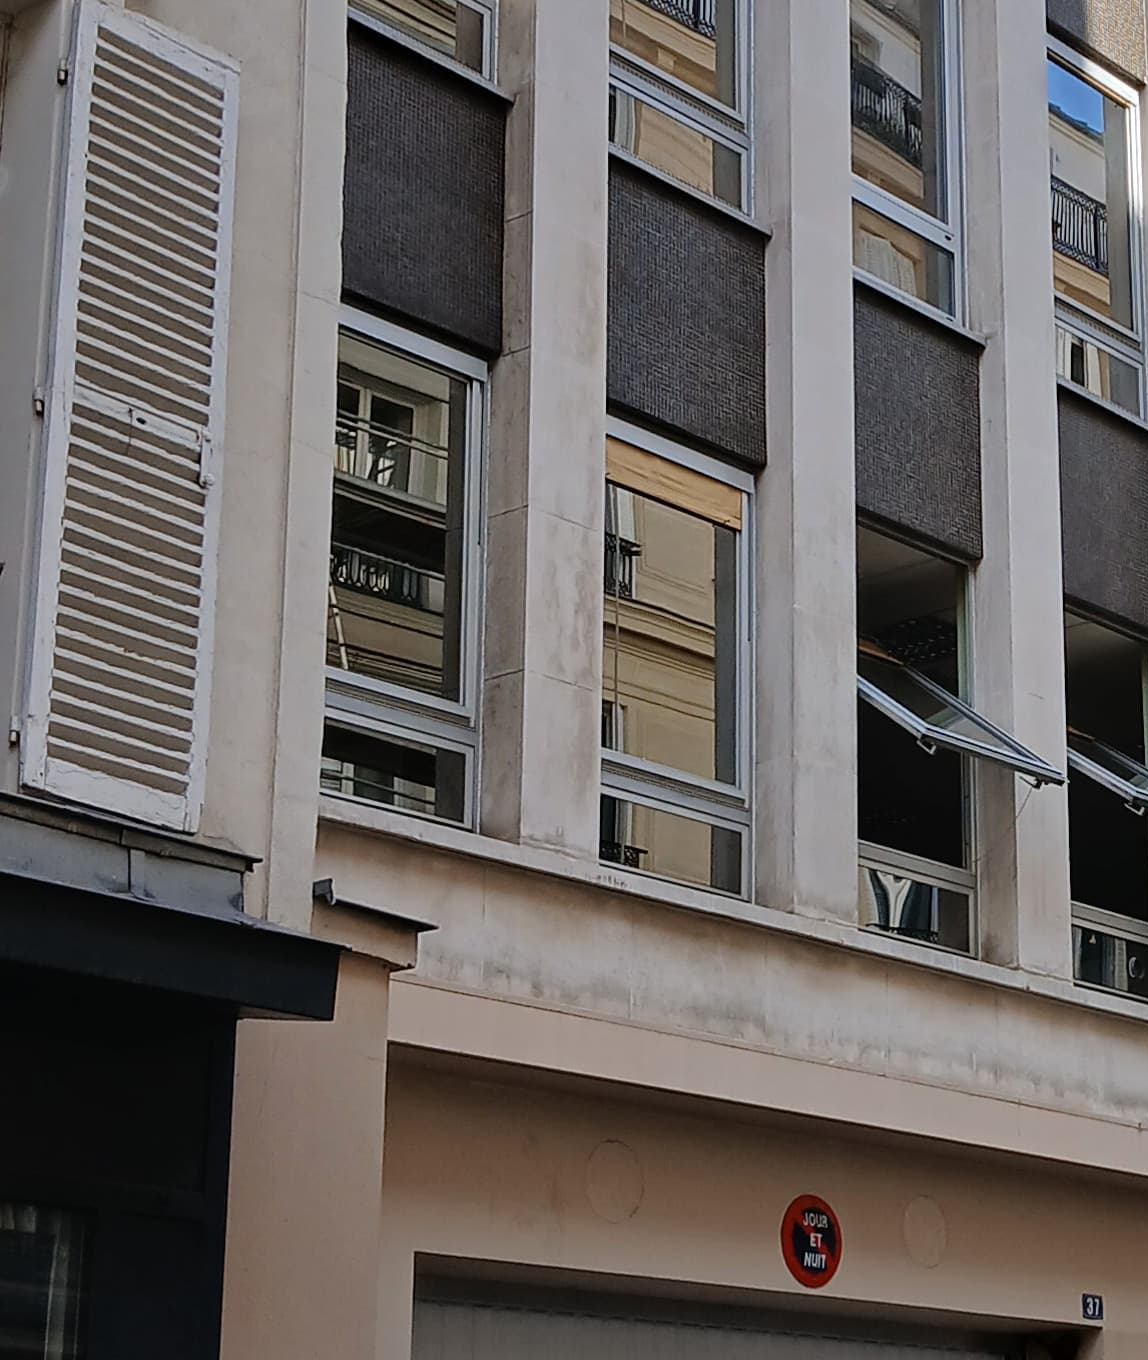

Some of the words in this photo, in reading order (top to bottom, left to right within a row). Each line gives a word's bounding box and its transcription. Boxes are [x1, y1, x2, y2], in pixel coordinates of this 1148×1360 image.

[802, 1212, 829, 1228] JOUR
[809, 1232, 823, 1248] ET
[803, 1251, 826, 1269] NUIT
[1086, 1296, 1100, 1316] 37
